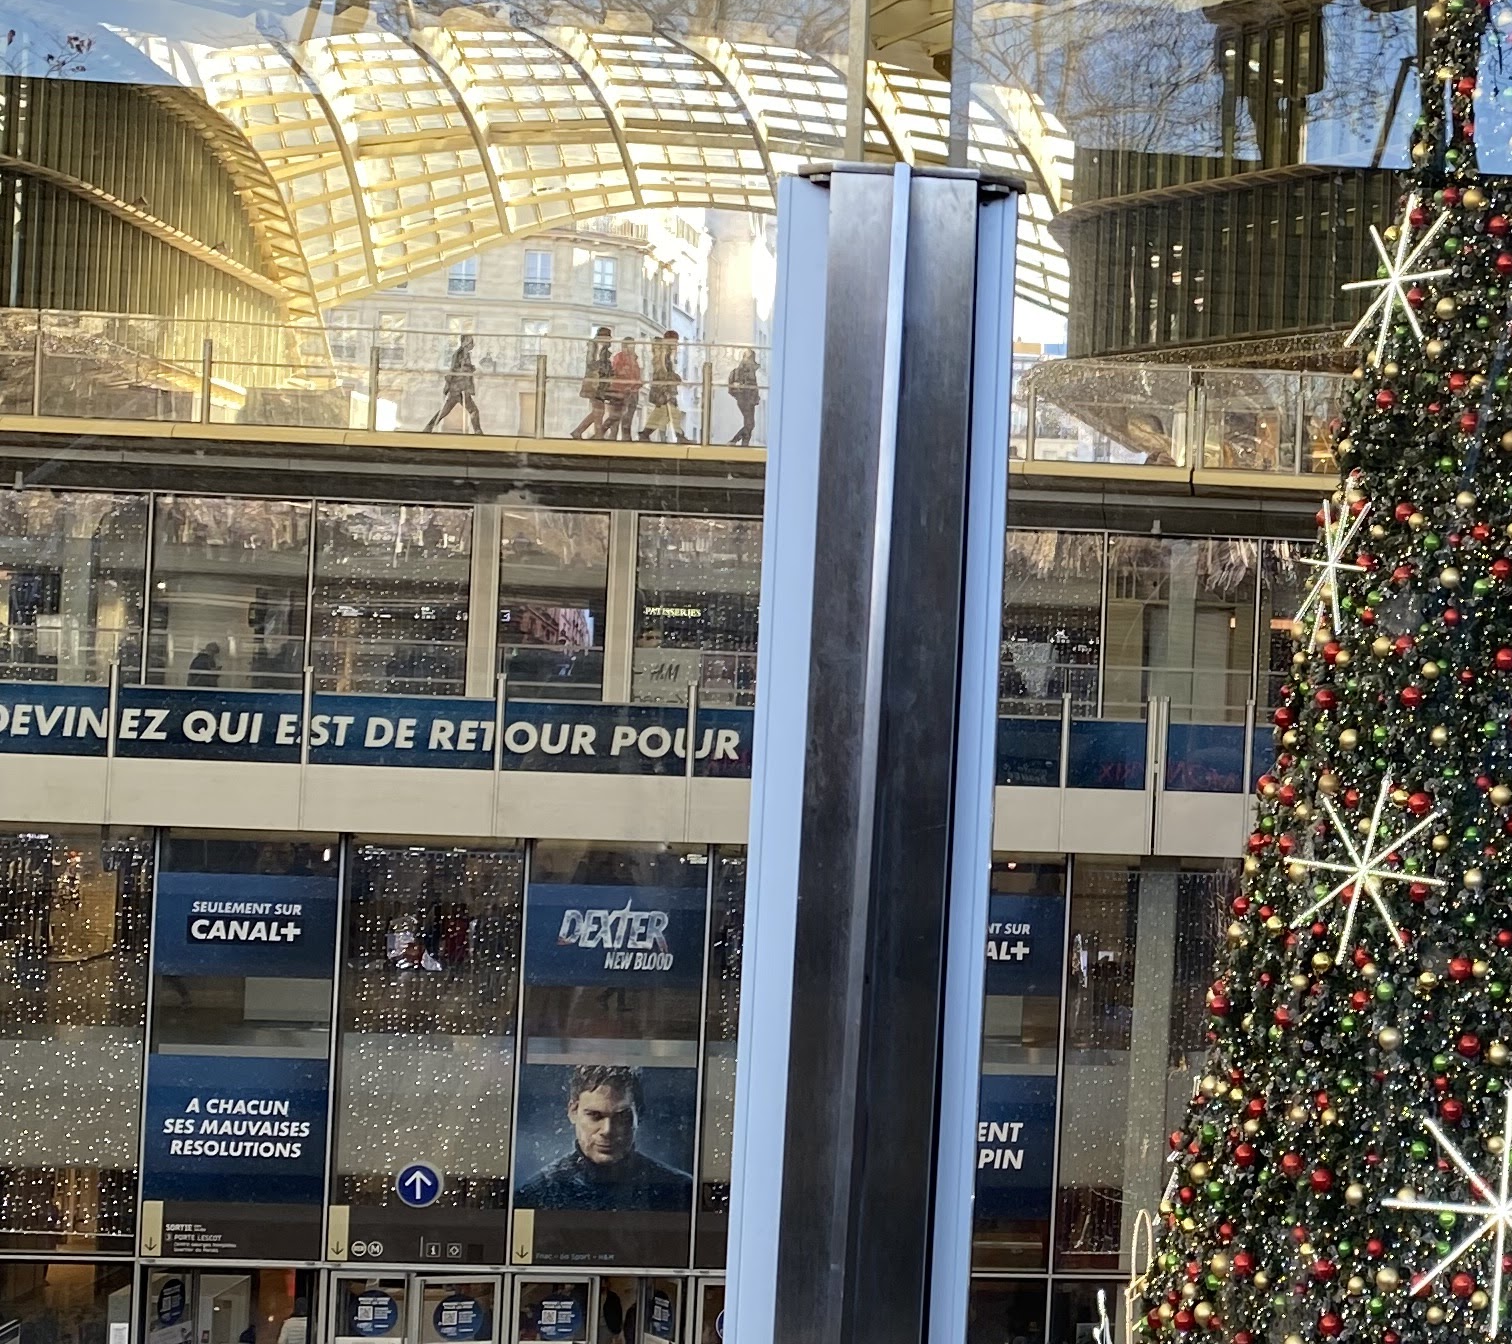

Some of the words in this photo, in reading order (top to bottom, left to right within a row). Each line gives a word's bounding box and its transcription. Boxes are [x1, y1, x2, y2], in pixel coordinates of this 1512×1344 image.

[182, 710, 263, 744] QUI
[275, 713, 354, 747] EST
[364, 717, 417, 749] DE
[428, 719, 596, 756] RETOUR
[609, 726, 740, 761] POUR
[191, 901, 272, 915] SEULEMENT
[274, 903, 302, 916] SUR
[191, 919, 302, 942] CANAL+
[556, 896, 669, 953] DEXTER
[1003, 922, 1031, 935] SUR
[604, 952, 633, 970] NEW
[633, 953, 674, 972] BLOOD
[185, 1097, 200, 1114] A
[206, 1098, 290, 1117] CHACUN
[163, 1118, 195, 1134] SES
[200, 1119, 311, 1137] MAUVAISES
[169, 1139, 302, 1158] RESOLUTIONS
